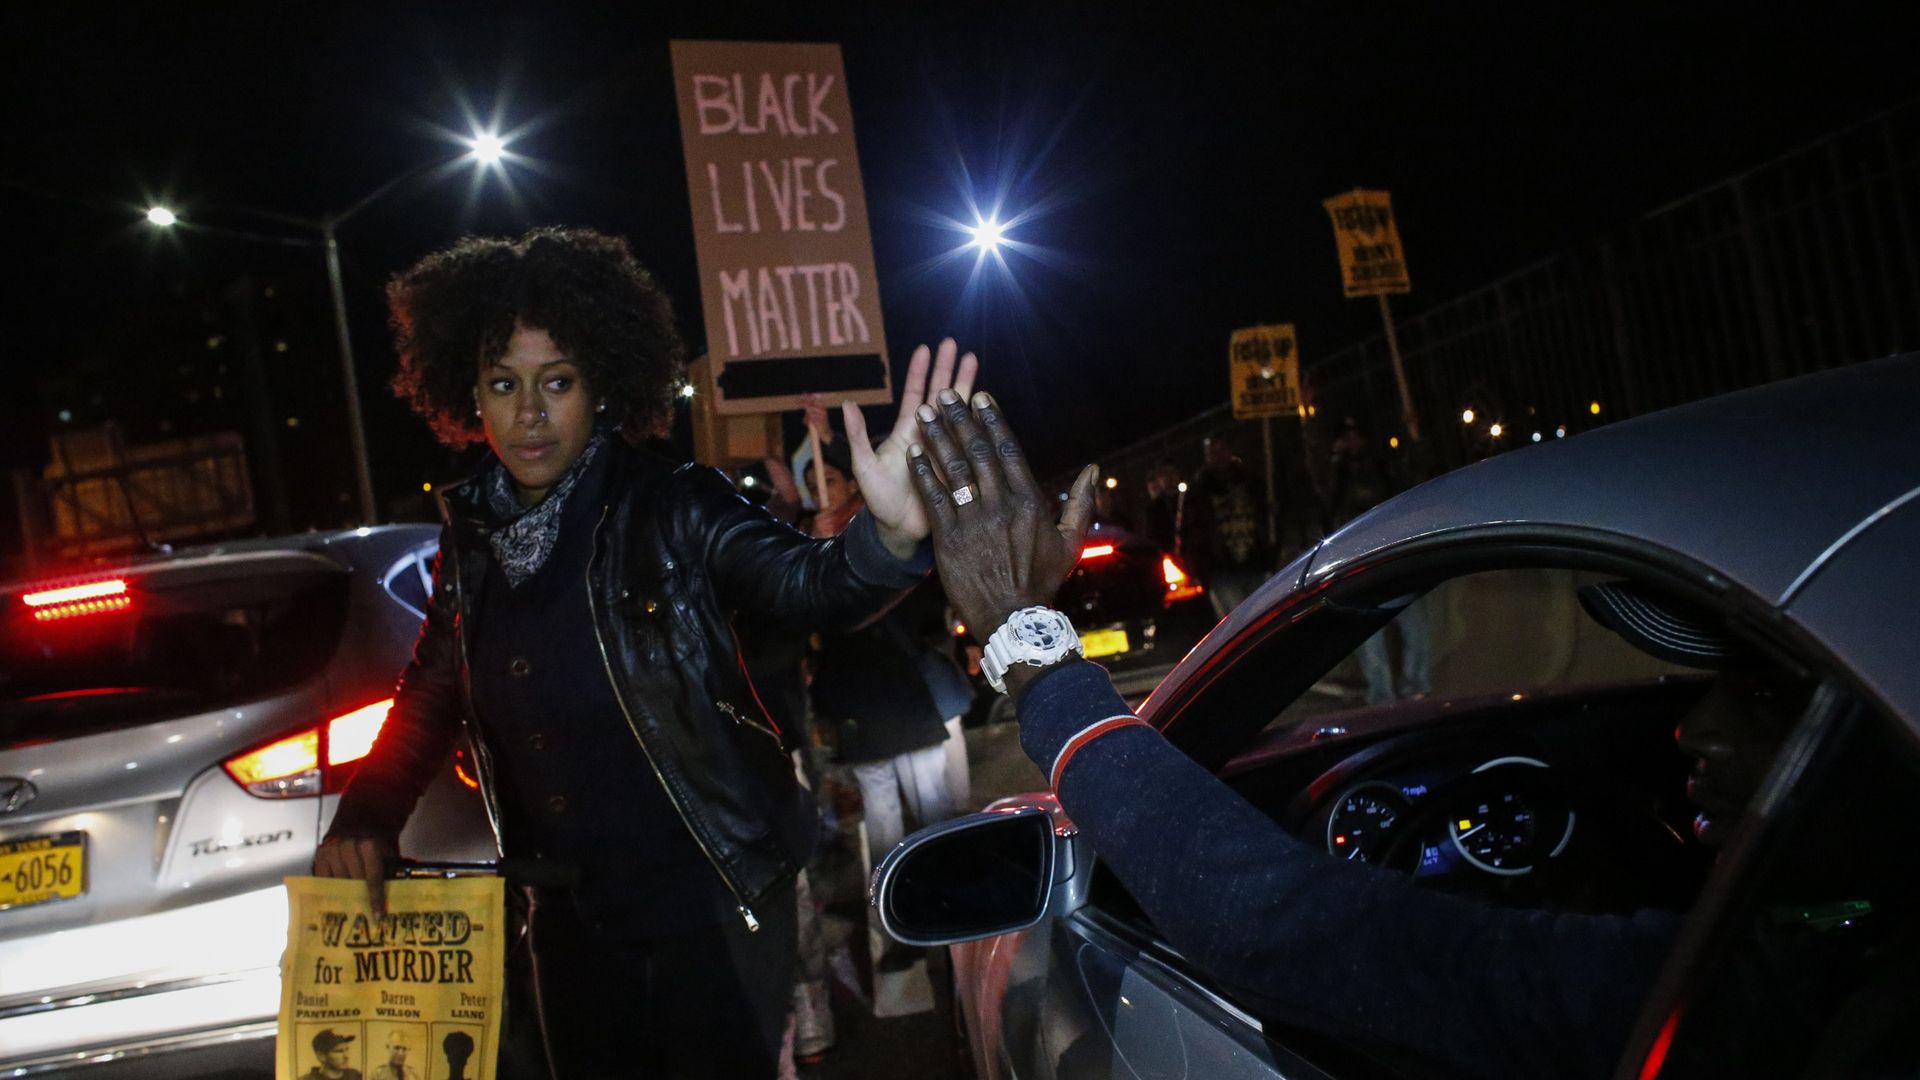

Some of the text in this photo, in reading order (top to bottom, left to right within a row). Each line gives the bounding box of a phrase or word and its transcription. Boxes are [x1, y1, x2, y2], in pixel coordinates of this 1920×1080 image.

[693, 72, 839, 137] BLACK
[708, 158, 847, 233] LIVES
[719, 261, 870, 356] MATTER
[15, 852, 72, 892] 6056
[314, 949, 474, 984] for MURDER
[296, 1008, 486, 1019] PANTALEO WILSON LIANG
[297, 990, 488, 1007] Daniel Darren Peter
